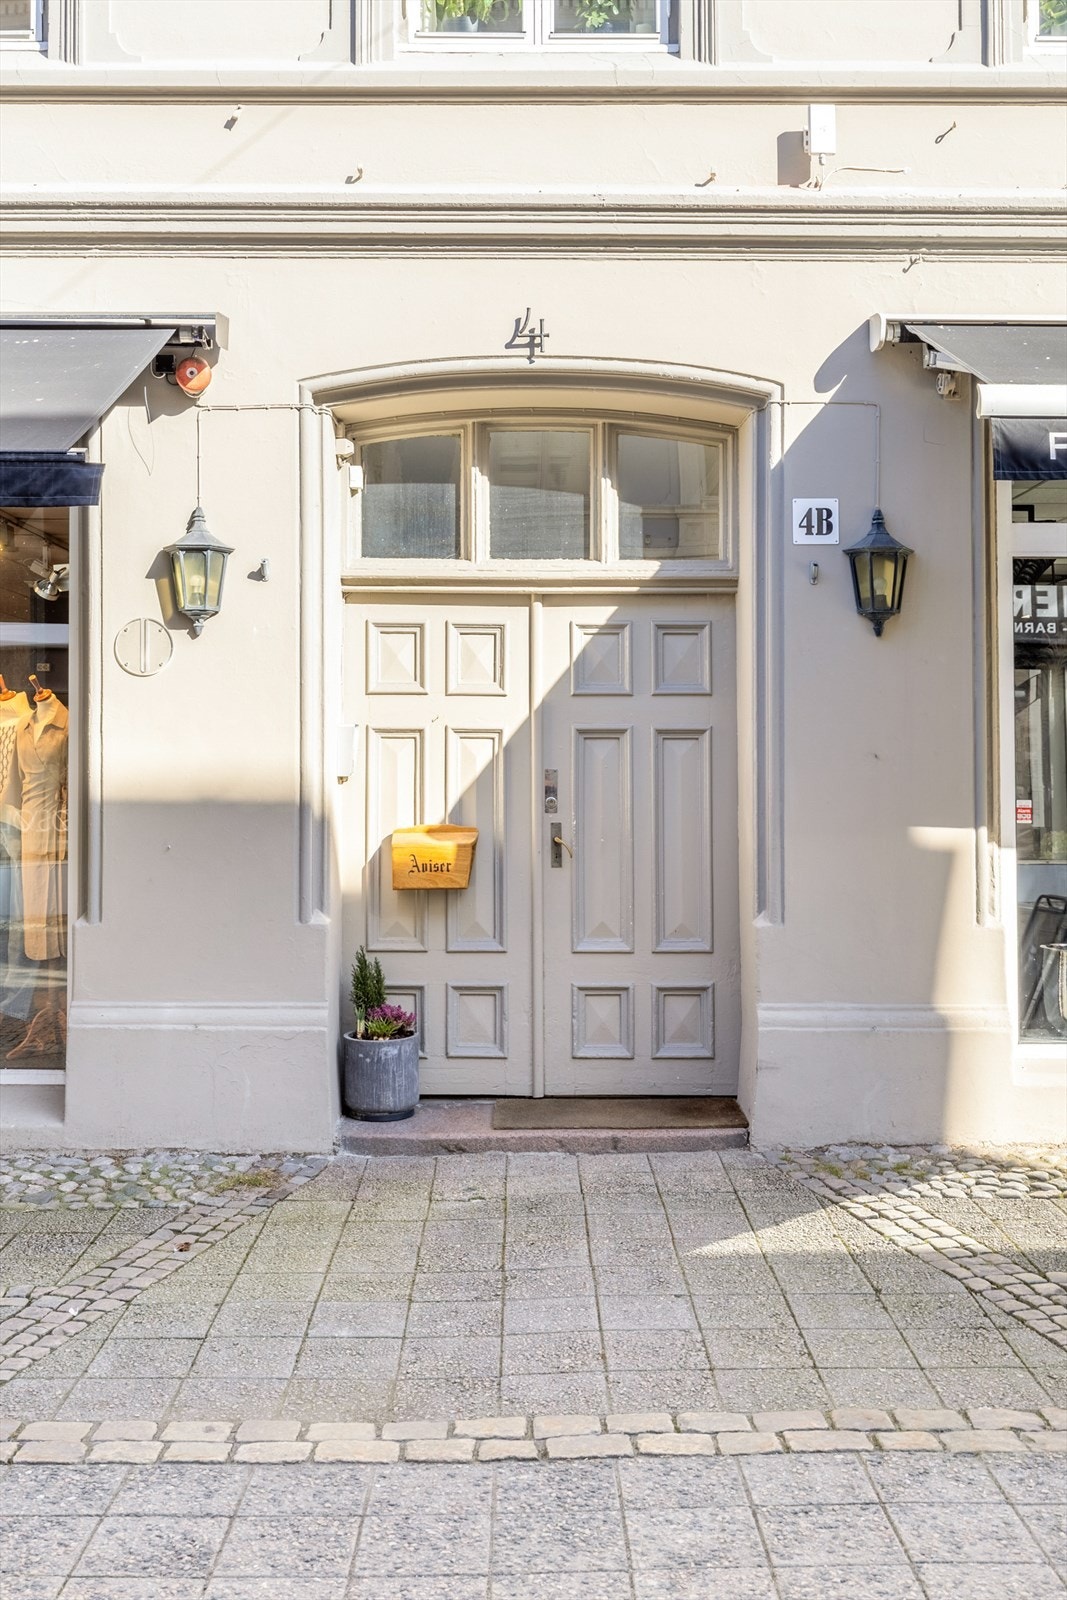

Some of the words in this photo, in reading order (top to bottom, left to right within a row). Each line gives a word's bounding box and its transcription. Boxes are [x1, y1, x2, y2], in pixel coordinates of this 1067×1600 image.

[518, 306, 550, 354] 4
[799, 507, 834, 536] 4B
[408, 853, 452, 878] Aviser
